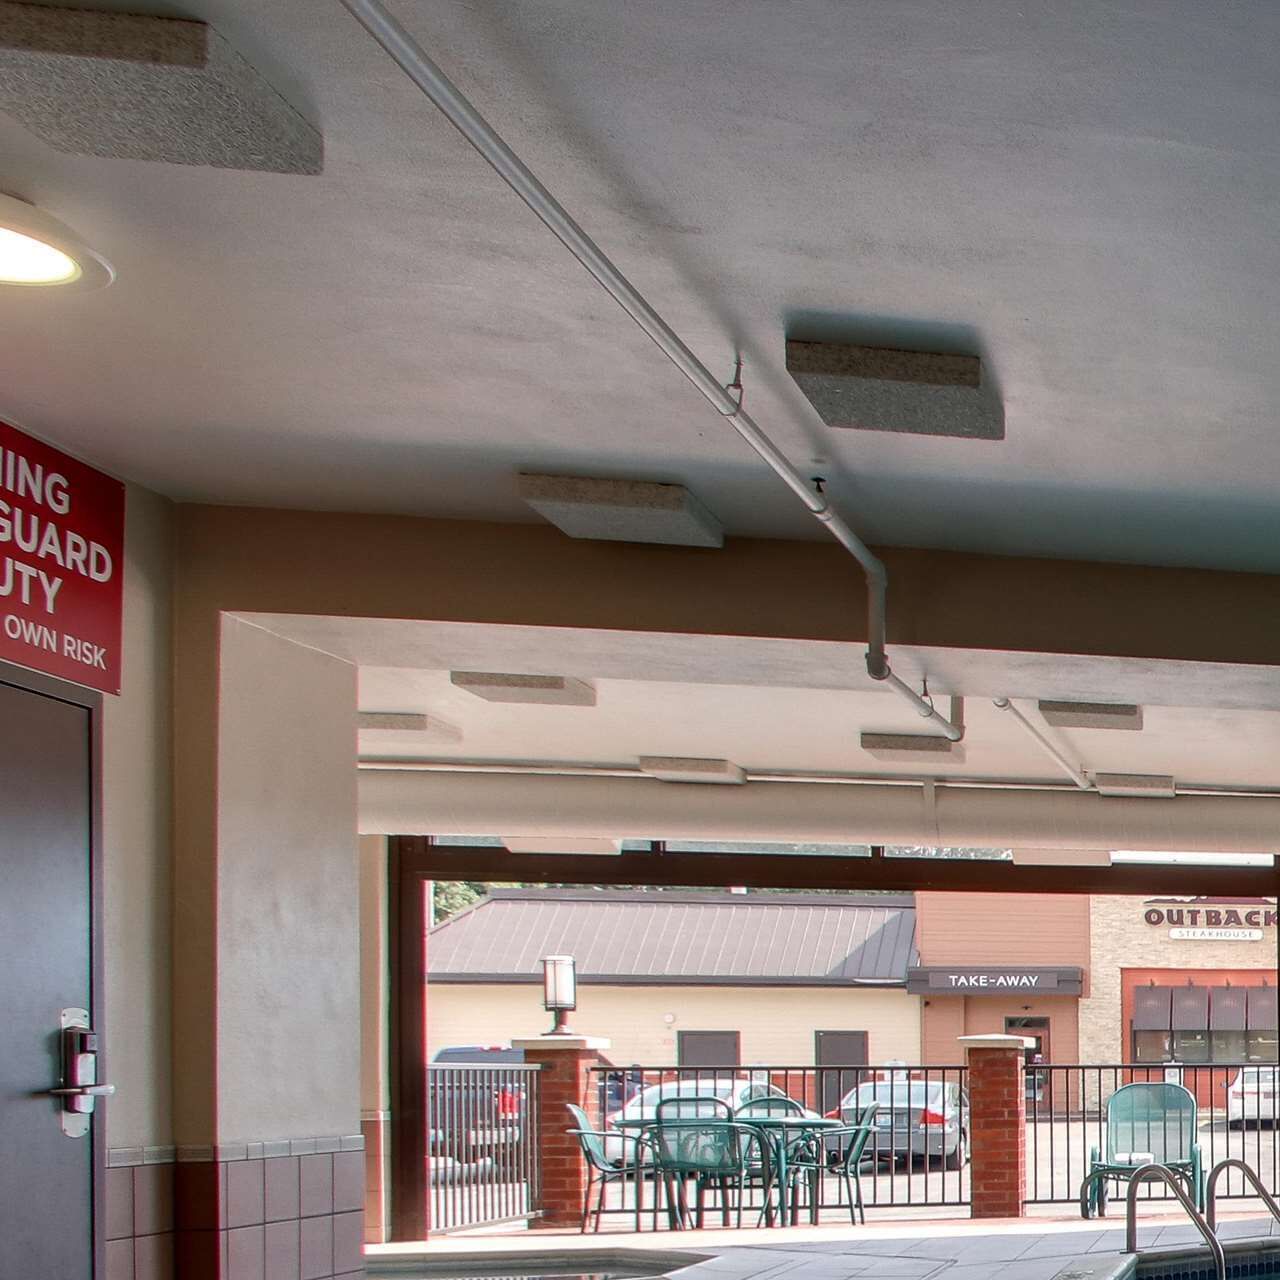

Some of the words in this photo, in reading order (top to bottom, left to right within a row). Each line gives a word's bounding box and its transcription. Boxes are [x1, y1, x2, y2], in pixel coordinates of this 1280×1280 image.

[0, 447, 70, 515] ING
[4, 614, 57, 653] OWN
[63, 635, 107, 670] RISK
[1144, 908, 1278, 926] OUTBACK
[1178, 929, 1254, 939] STEAKHOUSE
[948, 975, 1039, 986] TAKE-AWAY
